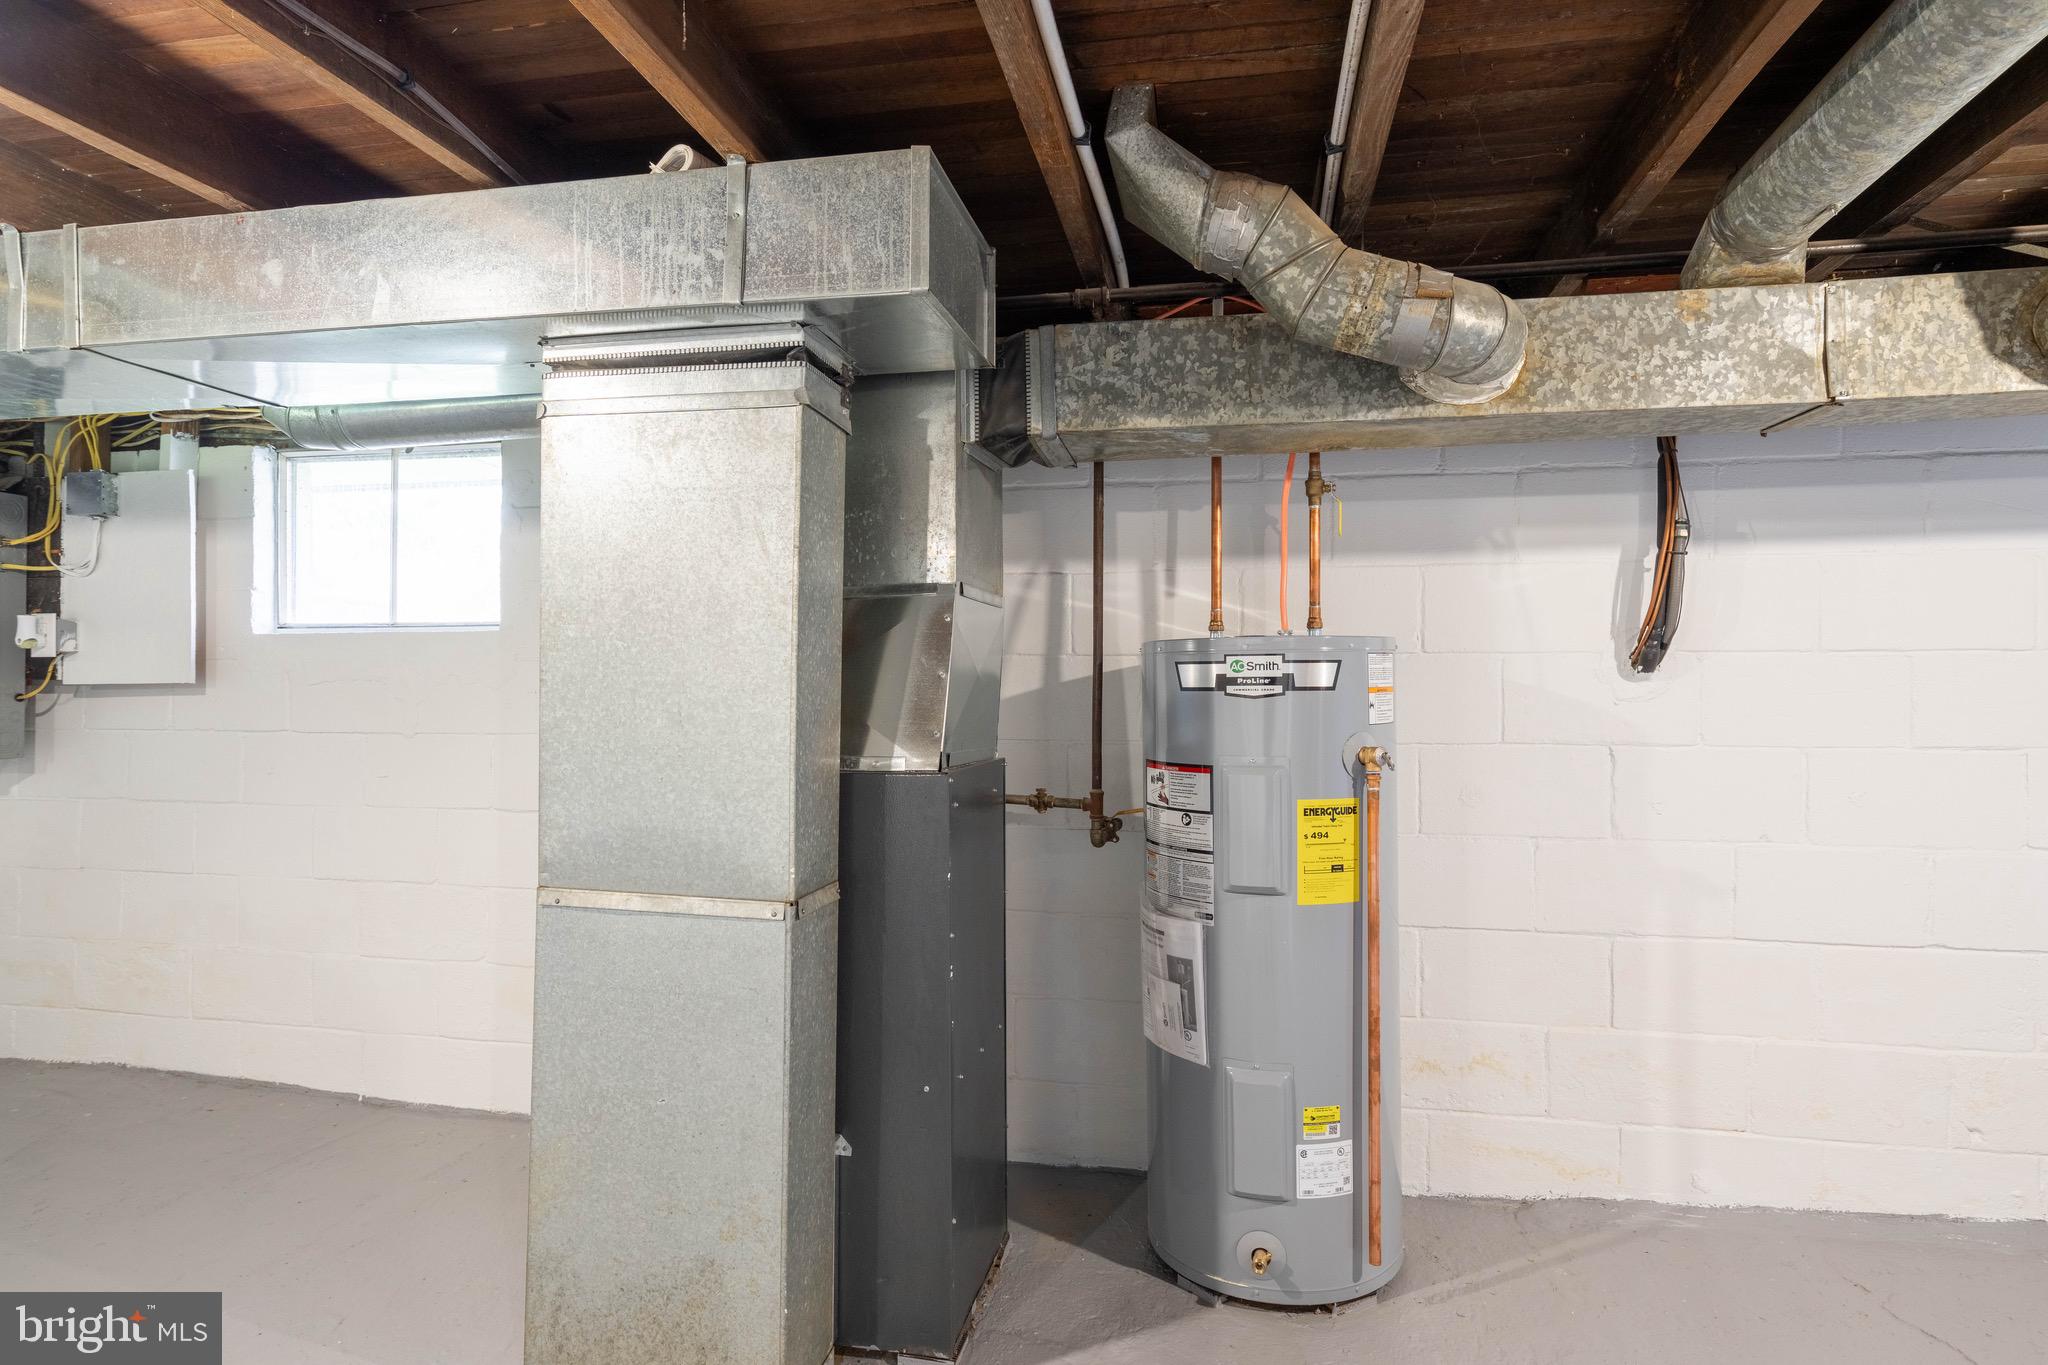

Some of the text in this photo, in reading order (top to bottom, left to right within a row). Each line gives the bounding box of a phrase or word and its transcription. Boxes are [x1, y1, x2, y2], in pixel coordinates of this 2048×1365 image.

[1246, 661, 1279, 671] Smith
[1303, 806, 1358, 818] ENERGYGUIDE
[1311, 832, 1329, 840] 494
